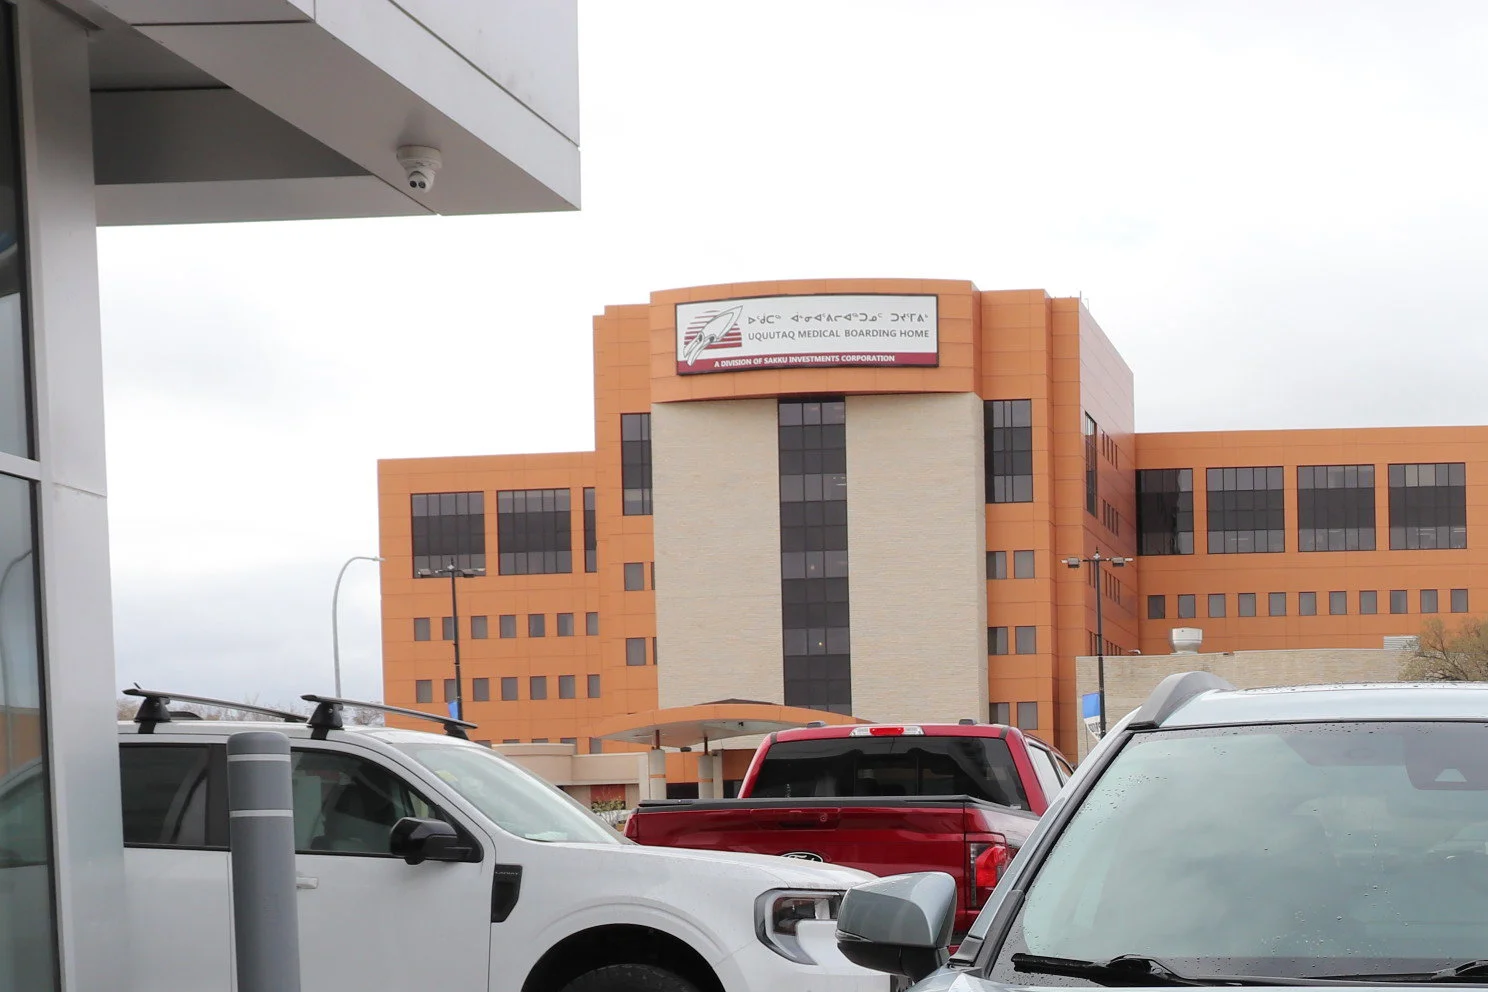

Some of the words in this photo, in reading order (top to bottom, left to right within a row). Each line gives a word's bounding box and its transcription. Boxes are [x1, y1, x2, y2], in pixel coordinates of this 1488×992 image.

[748, 330, 796, 341] UQUUTAQ
[798, 329, 840, 338] MEDICAL
[844, 329, 897, 338] BOARDING
[900, 329, 929, 338] HOME
[714, 360, 720, 368] A
[721, 358, 752, 367] DIVISION
[753, 357, 763, 365] OF
[763, 356, 788, 364] SAKKU
[789, 354, 840, 363] INVESTMENTS
[841, 354, 895, 362] CORPORATION
